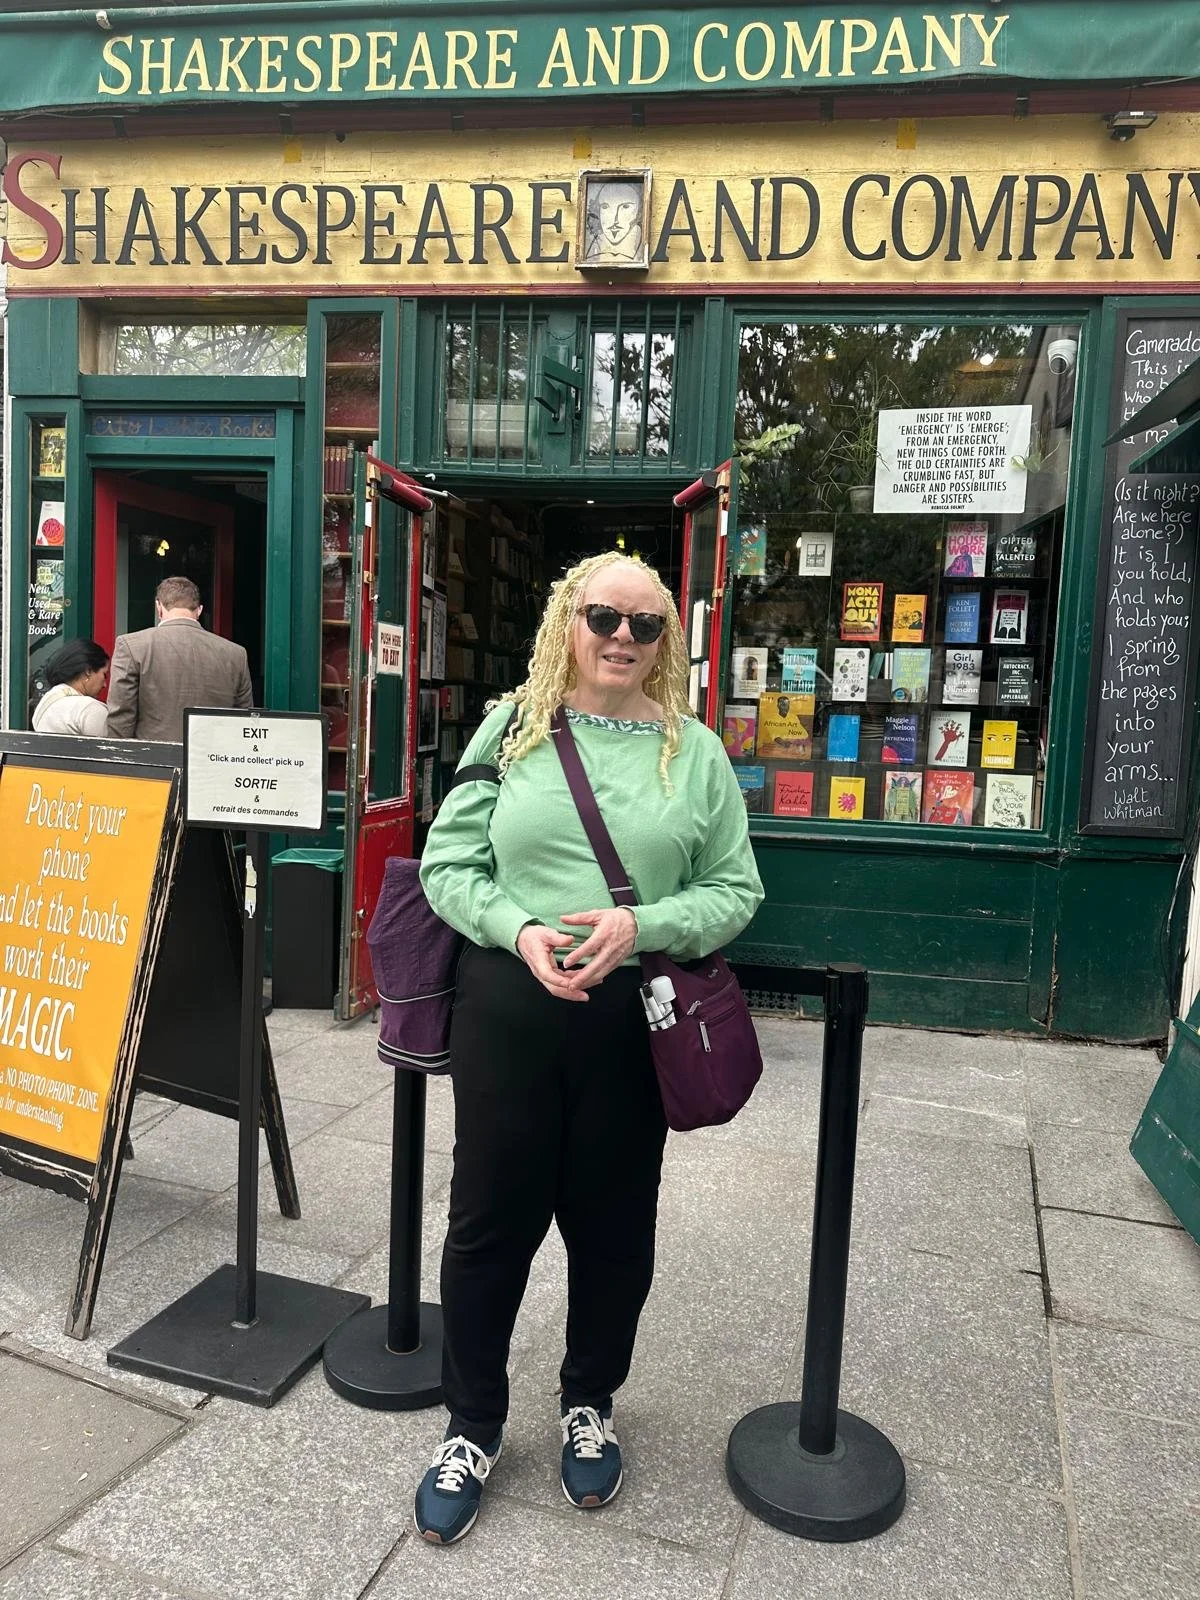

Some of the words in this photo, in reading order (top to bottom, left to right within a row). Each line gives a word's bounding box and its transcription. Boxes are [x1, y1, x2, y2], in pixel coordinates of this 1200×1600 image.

[97, 30, 518, 96] SHAKESPEARE
[537, 24, 671, 90] AND
[692, 13, 1010, 83] COMPANY
[2, 151, 572, 270] SHAKESPEARE
[650, 178, 821, 263] AND
[843, 172, 1200, 262] COMPAN
[1131, 360, 1168, 376] This
[916, 413, 944, 423] INSIDE
[948, 412, 962, 422] THE
[966, 412, 991, 421] WORD
[956, 424, 964, 433] IS
[907, 437, 929, 446] FROM
[933, 436, 943, 445] AN
[897, 449, 914, 458] NEW
[918, 448, 948, 457] THINGS
[952, 447, 974, 456] COME
[978, 446, 1007, 456] FORTH.
[898, 460, 911, 469] THE
[916, 460, 931, 469] OLD
[935, 458, 985, 468] CERTAINTIES
[989, 458, 1005, 467] ARE
[903, 471, 951, 481] CRUMBLING
[955, 470, 975, 481] FAST,
[979, 470, 994, 479] BUT
[893, 484, 925, 493] DANGER
[929, 483, 946, 492] AND
[950, 481, 1006, 492] POSSIBILITIES
[1137, 479, 1150, 501] it
[1154, 482, 1200, 508] night?
[922, 495, 937, 504] ARE
[941, 494, 974, 503] SISTERS.
[1113, 505, 1137, 523] Are
[1141, 512, 1158, 523] we
[1161, 508, 1191, 523] here
[948, 535, 985, 545] HOUSE
[1121, 523, 1184, 544] alone?)
[1114, 545, 1127, 564] It
[1139, 545, 1154, 563] is
[1164, 543, 1170, 564] I
[1113, 569, 1145, 587] you
[1149, 562, 1192, 584] hold,
[847, 587, 879, 596] MONA
[1109, 587, 1146, 606] And
[1154, 586, 1184, 605] who
[28, 597, 52, 609] Used
[846, 596, 878, 608] ACTS
[28, 609, 36, 620] &
[38, 609, 61, 620] Rare
[844, 608, 878, 621] OUT
[1115, 607, 1157, 628] holds
[1160, 614, 1190, 637] you;
[28, 624, 57, 635] Books
[382, 647, 389, 665] TO
[389, 649, 400, 666] EXIT
[1124, 636, 1180, 666] spring
[952, 663, 975, 671] 1983
[1117, 656, 1160, 682] from
[1101, 680, 1128, 700] the
[1133, 684, 1177, 710] pages
[885, 716, 909, 724] Maggie
[1115, 710, 1155, 732] into
[243, 728, 269, 739] EXIT
[1105, 740, 1154, 763] your
[275, 758, 292, 767] pick
[1104, 763, 1174, 782] arms...
[234, 777, 278, 790] SORTIE
[1114, 787, 1149, 805] Walt
[25, 783, 85, 831] Pocket
[83, 803, 128, 844] your
[212, 805, 236, 813] retrait
[237, 806, 251, 814] des
[252, 808, 299, 817] commandes
[1104, 805, 1163, 820] Whitman
[38, 835, 91, 886] phone
[19, 884, 44, 930] let
[46, 889, 74, 935] the
[77, 895, 129, 946] books
[4, 937, 45, 980] work
[48, 940, 91, 990] their
[5, 1067, 17, 1087] NO
[17, 1071, 76, 1105] PHOTO/PHONE
[4, 1092, 16, 1111] for
